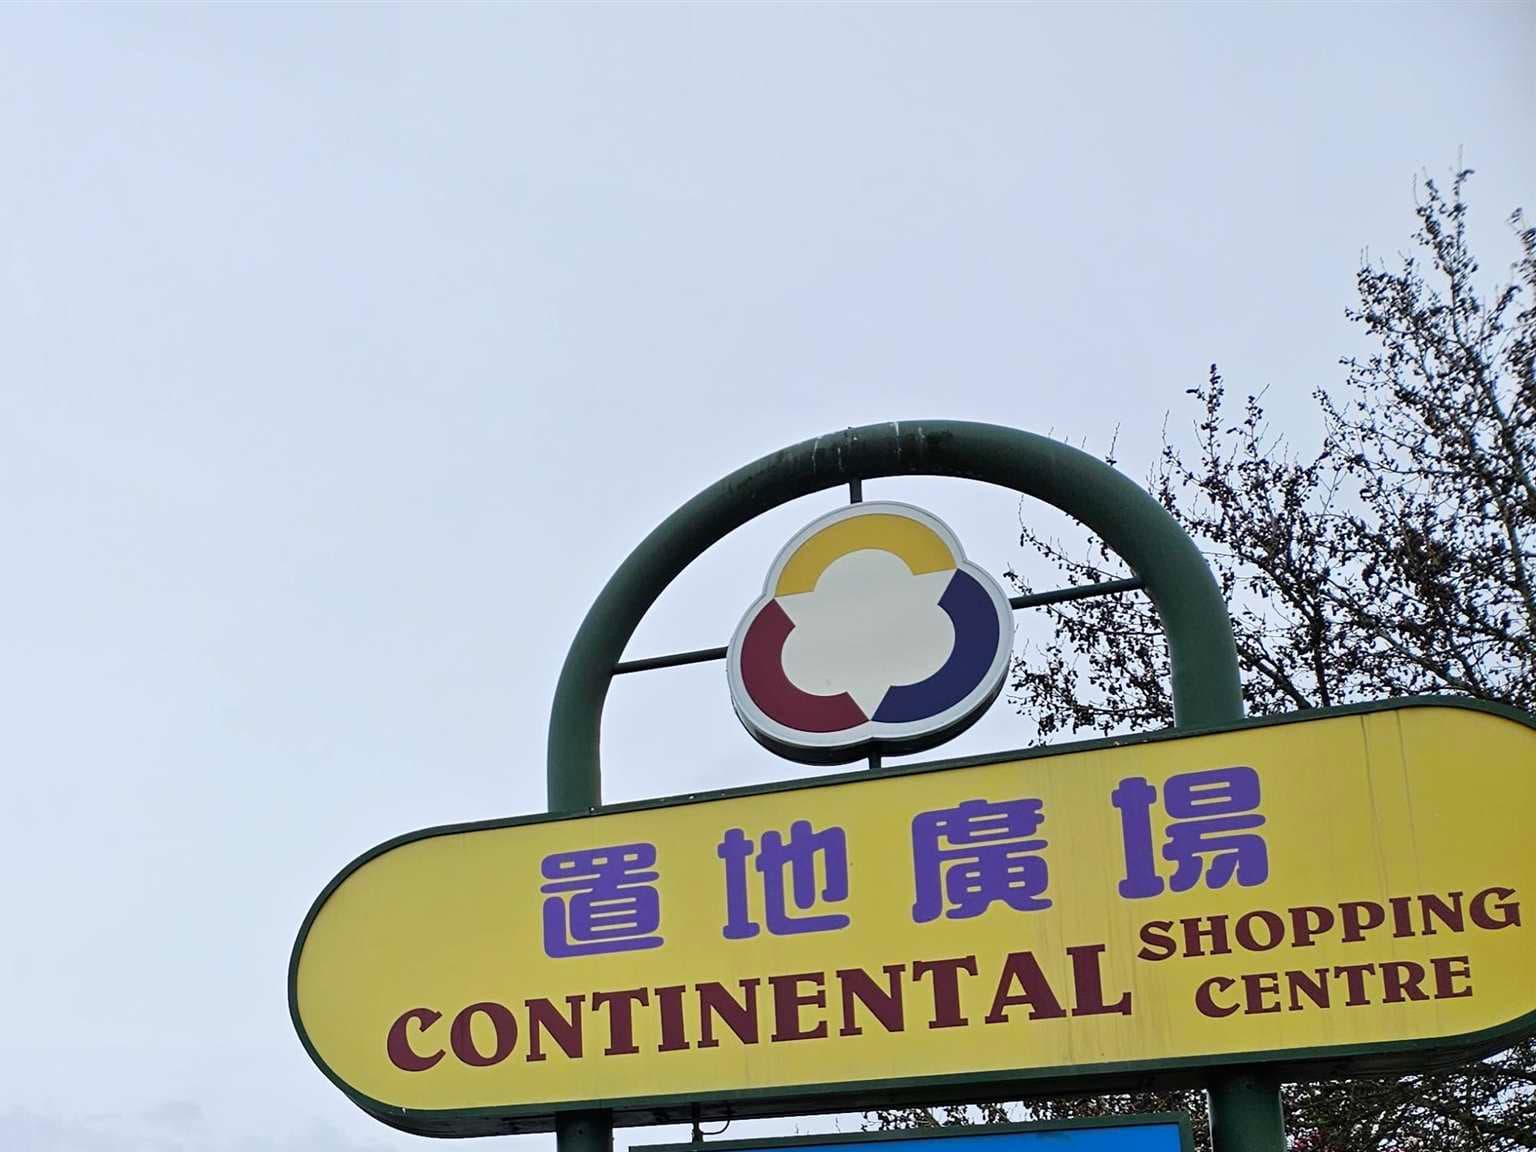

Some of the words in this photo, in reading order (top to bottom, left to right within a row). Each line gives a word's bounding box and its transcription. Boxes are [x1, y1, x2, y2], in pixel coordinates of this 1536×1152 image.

[539, 765, 1270, 960] 置地廣場
[1137, 885, 1523, 964] SHOPPING
[385, 942, 1133, 1074] CONTINENTAL
[1194, 954, 1475, 1020] CENTRE
